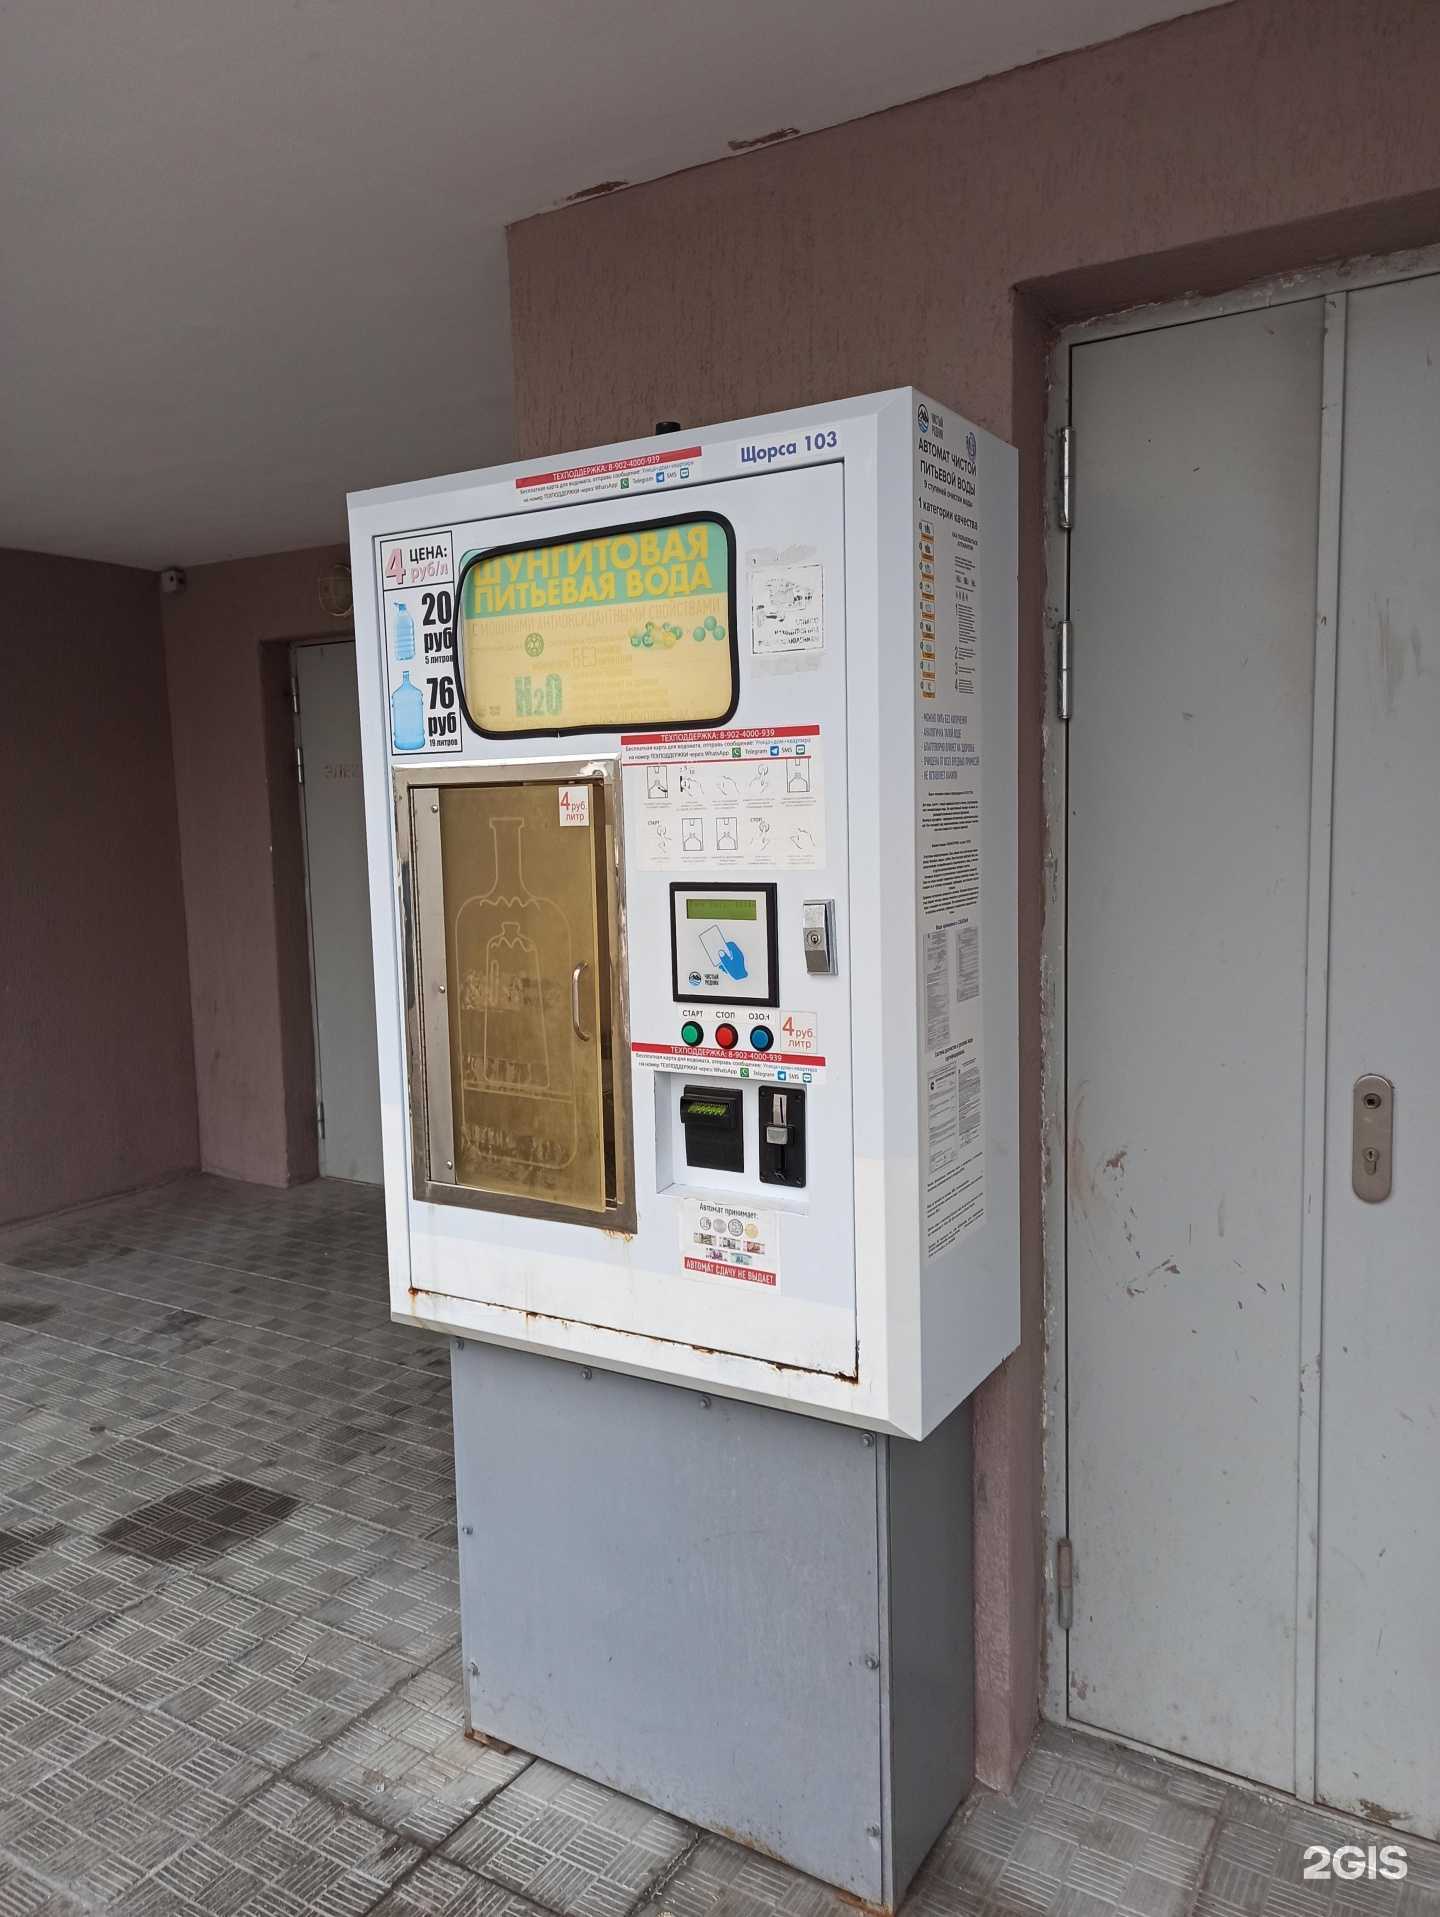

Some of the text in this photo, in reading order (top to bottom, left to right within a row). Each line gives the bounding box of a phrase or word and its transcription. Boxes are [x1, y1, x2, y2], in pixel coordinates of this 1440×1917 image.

[741, 431, 838, 463] Щорса 103
[918, 437, 977, 477] АВТОМАТ ЧИСТОЙ
[552, 454, 661, 482] ТЕХПОДДЕРЖКА: 8-902-4000-939
[595, 481, 618, 494] WhatsApp
[920, 460, 976, 497] ПИТЬЕВОЙ ВОДЫ
[918, 496, 978, 531] 1 категории качества
[409, 545, 448, 564] ЦЕНА:
[474, 526, 710, 586] ШУНГИТОВАЯ
[385, 547, 407, 585] 4
[474, 561, 713, 614] ПИТЬЕВАЯ ВОДА
[421, 591, 452, 626] 20
[424, 627, 453, 654] руб
[424, 656, 430, 665] 5
[426, 675, 456, 710] 76
[427, 711, 457, 737] руб
[429, 738, 458, 747] 19 литров
[660, 729, 775, 745] ТЕХПОДДЕРЖКА: 8-902-4000-939
[704, 750, 730, 761] WhatsApp
[744, 748, 768, 758] Telegram
[781, 747, 793, 755] SMS
[560, 791, 571, 811] 4
[566, 813, 585, 823] литр
[682, 1009, 704, 1018] СТАРТ
[715, 1011, 736, 1020] СТОП
[782, 1016, 795, 1037] 4
[670, 1046, 783, 1064] ТЕХПОДДЕРЖКА: 8-902-4000-939
[788, 1039, 812, 1052] литр
[713, 1066, 738, 1077] WhatsApp
[699, 1202, 760, 1220] Автомат принимает:
[685, 1259, 775, 1286] АВТОМАТ СДАЧУ НЕ ВЫДАЕТ
